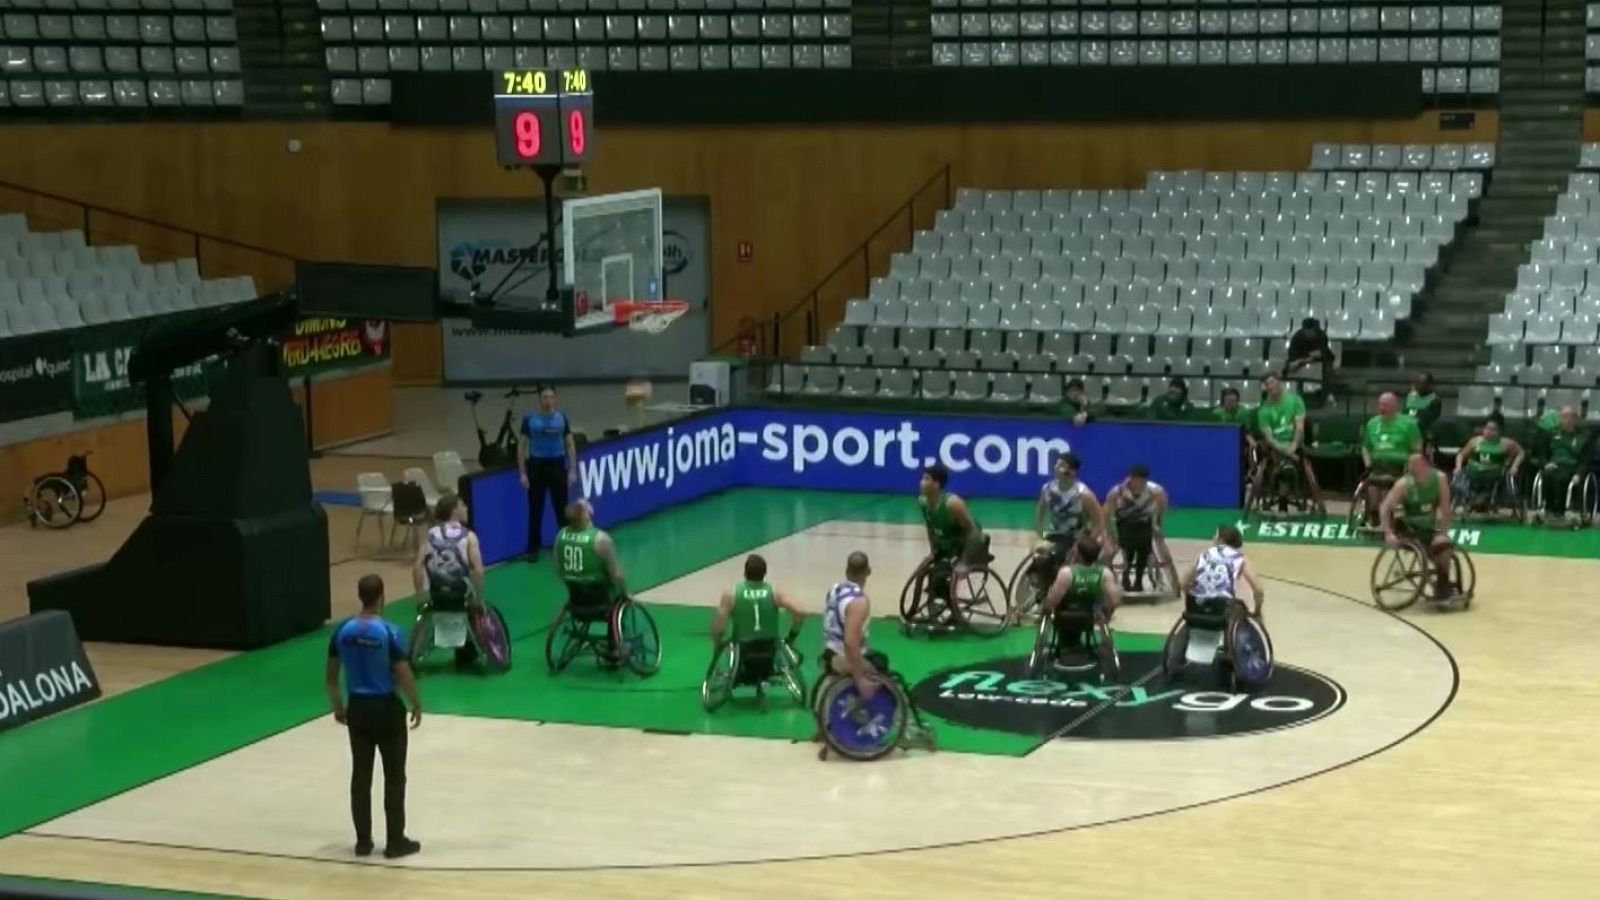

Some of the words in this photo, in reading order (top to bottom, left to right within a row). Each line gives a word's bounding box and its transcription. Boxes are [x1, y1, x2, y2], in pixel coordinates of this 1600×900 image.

[504, 71, 547, 94] 7:40
[564, 69, 587, 92] 7:40
[516, 112, 540, 157] 9
[571, 110, 584, 155] 9
[0, 363, 33, 384] ospital
[579, 420, 1071, 499] www.joma-sport.com
[1257, 520, 1357, 540] ESTREL
[563, 544, 584, 572] 90
[753, 602, 761, 632] 1
